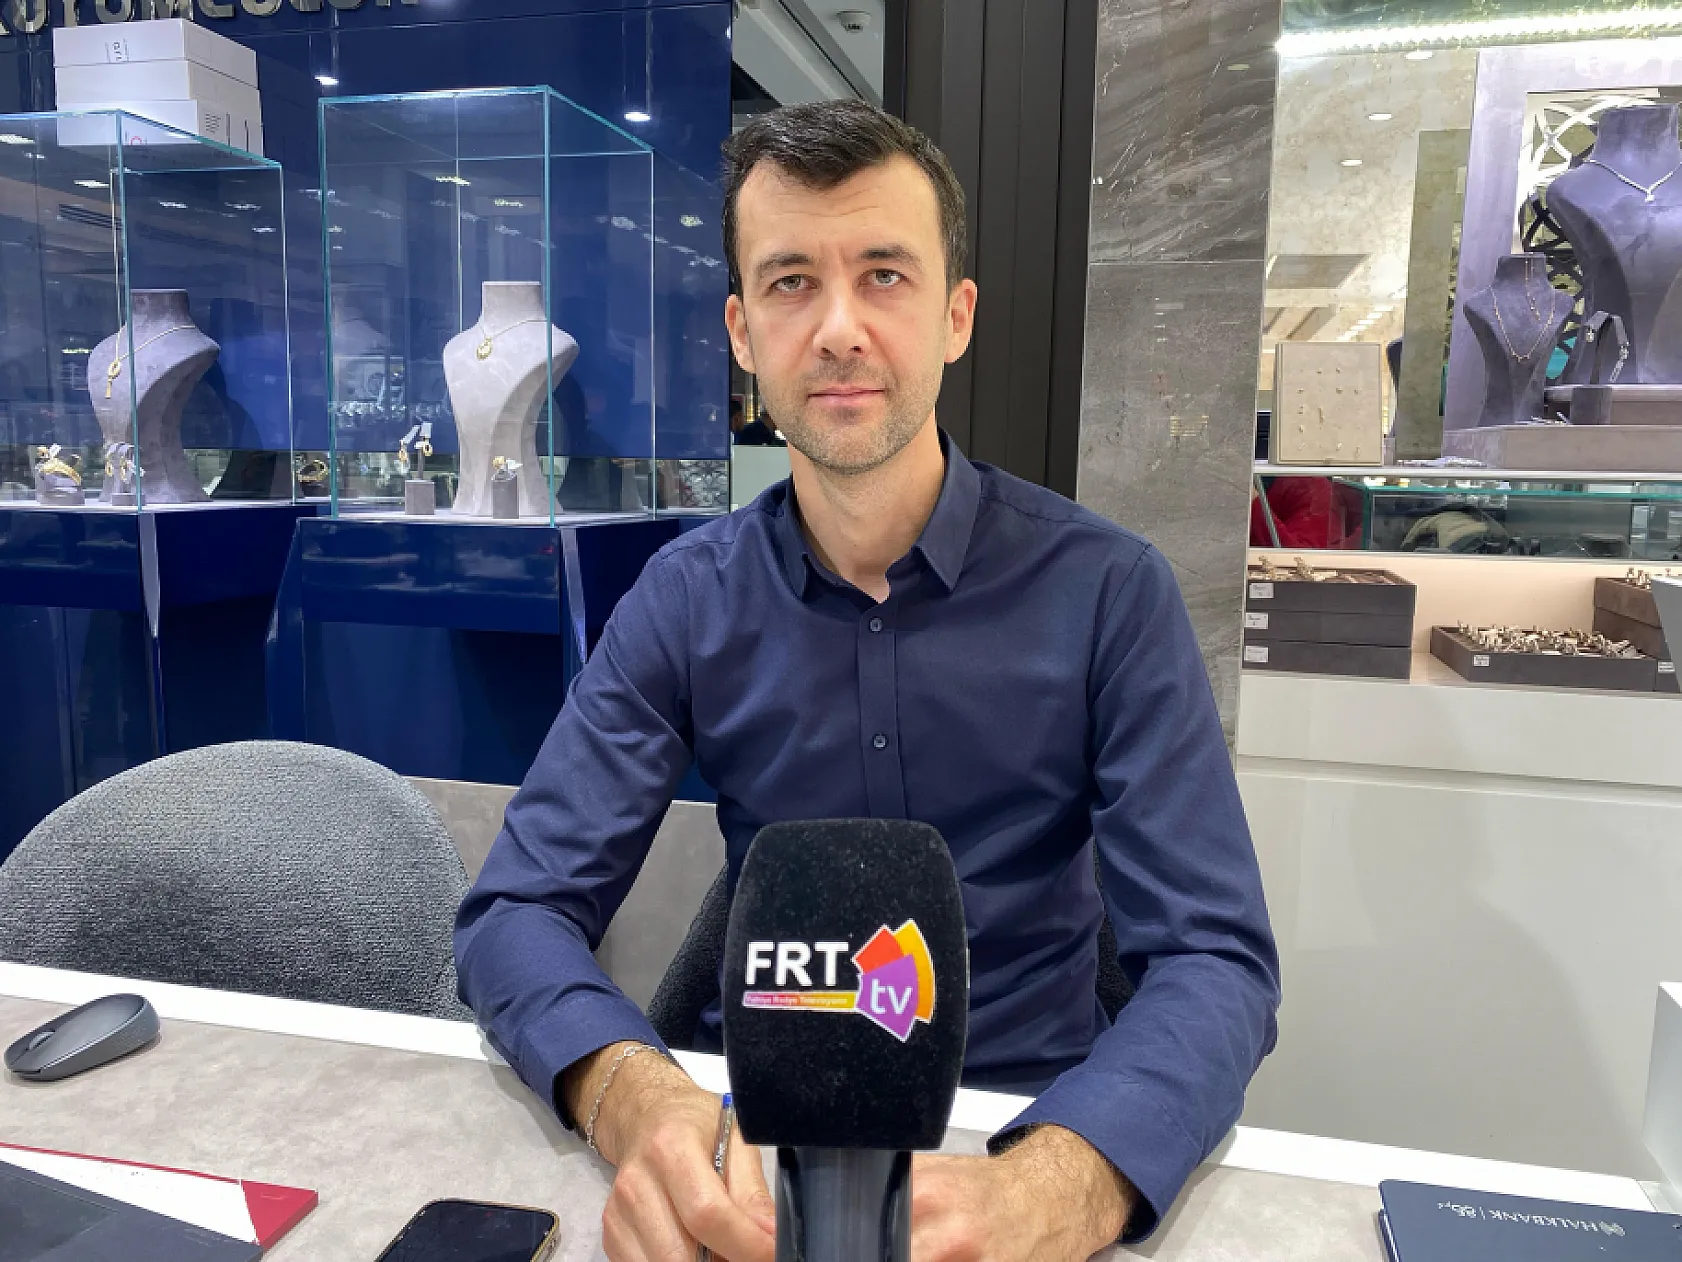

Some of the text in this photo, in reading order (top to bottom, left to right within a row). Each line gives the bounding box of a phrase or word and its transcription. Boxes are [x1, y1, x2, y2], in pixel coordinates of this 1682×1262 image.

[745, 941, 913, 1015] FRT tv
[1488, 1208, 1598, 1232] HALKBANK
